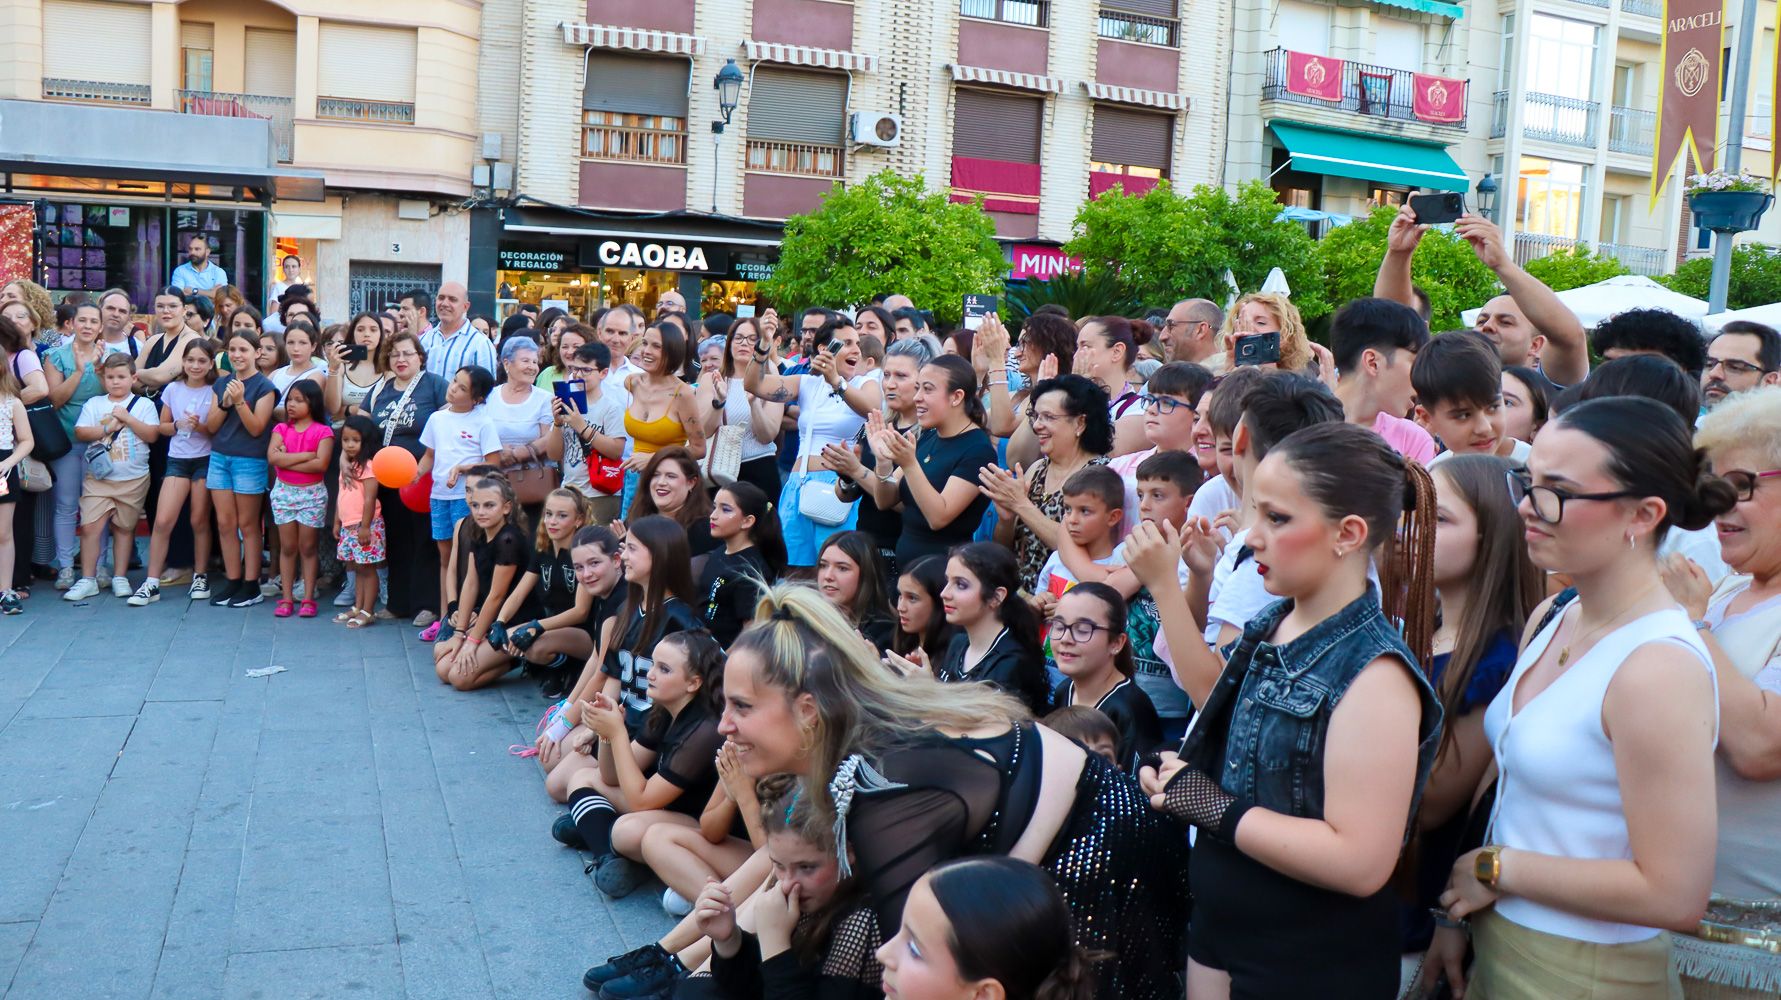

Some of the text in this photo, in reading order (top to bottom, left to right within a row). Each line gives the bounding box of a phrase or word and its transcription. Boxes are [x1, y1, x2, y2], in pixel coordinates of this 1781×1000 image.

[1667, 9, 1722, 35] ARACELI
[393, 244, 400, 253] 3
[500, 251, 564, 261] DECORACIÓN
[599, 241, 709, 270] CAOBA
[505, 260, 559, 270] Y REGALOS
[740, 271, 746, 279] Y
[618, 649, 654, 712] 23
